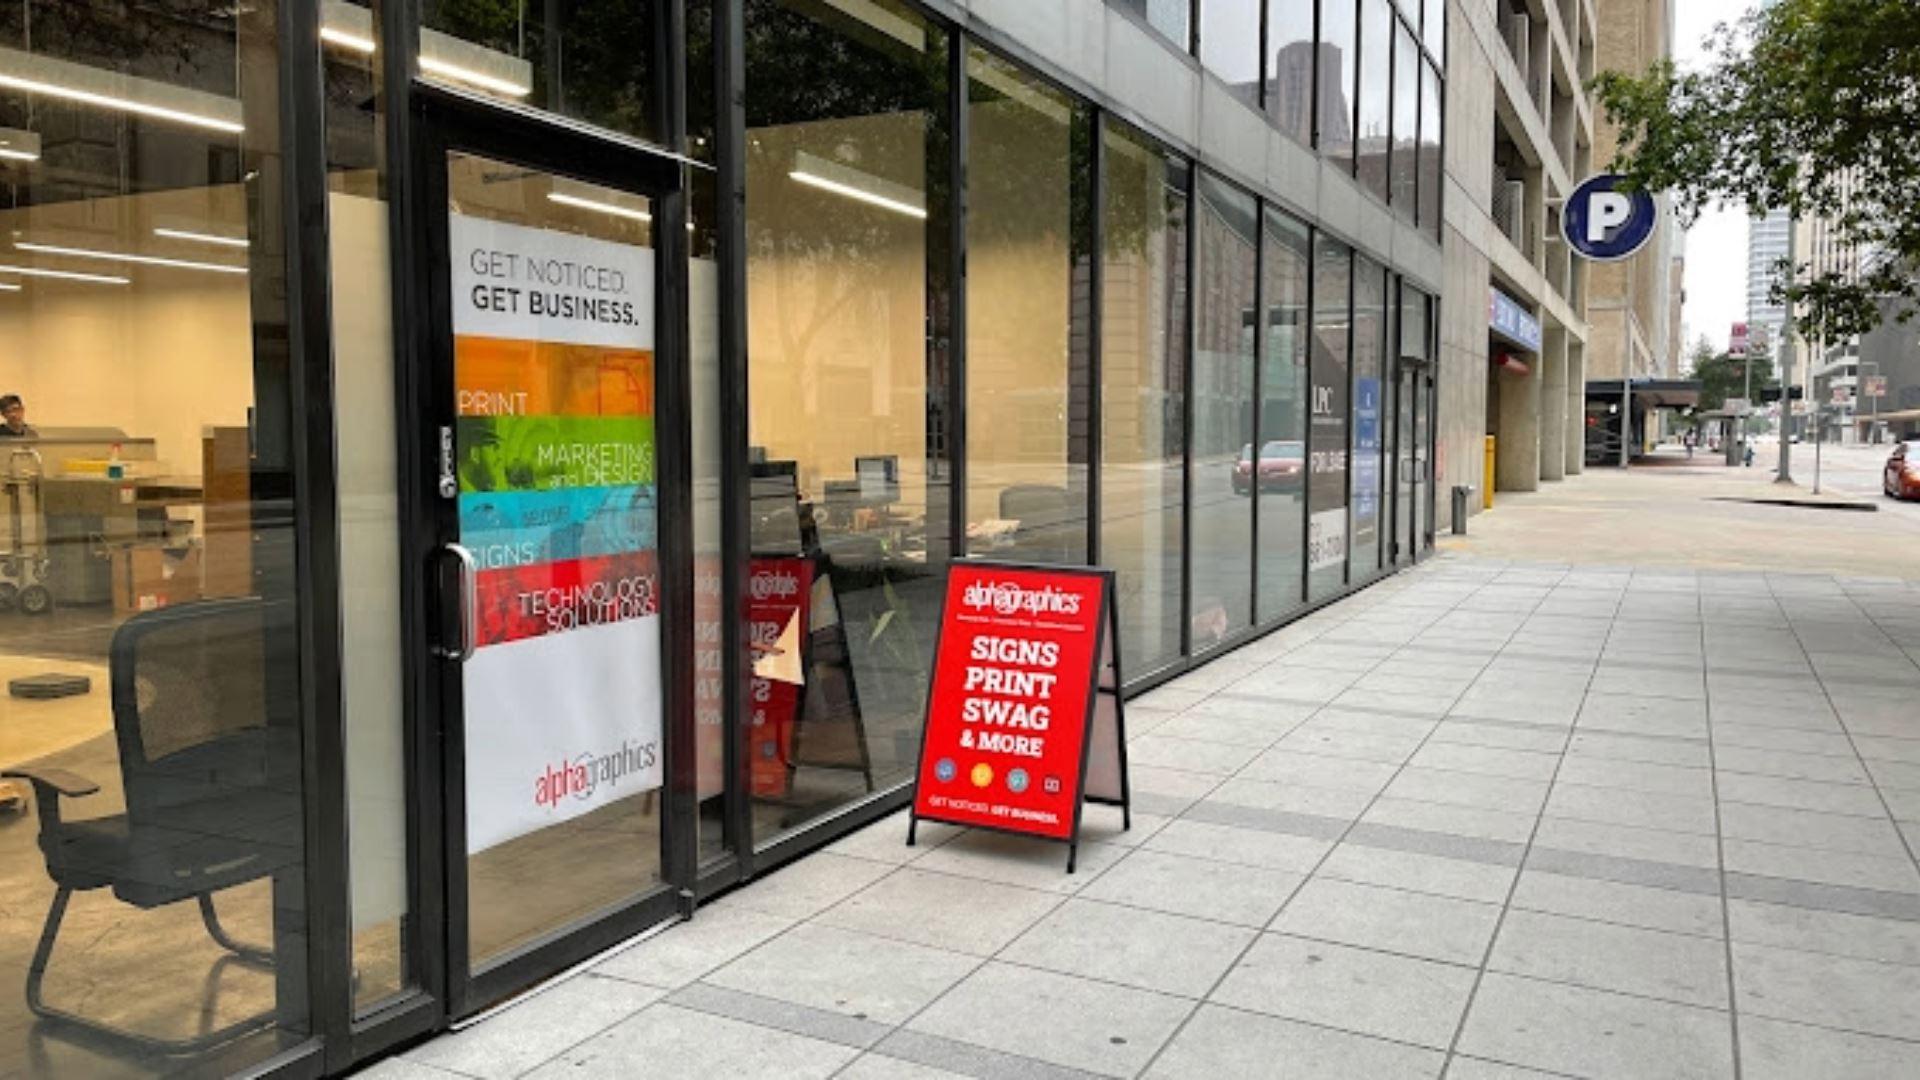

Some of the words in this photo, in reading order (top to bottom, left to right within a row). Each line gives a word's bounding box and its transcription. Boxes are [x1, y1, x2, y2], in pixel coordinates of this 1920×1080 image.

[1588, 192, 1630, 241] P
[470, 249, 518, 279] GET
[472, 285, 521, 313] GET
[530, 290, 639, 326] BUSINESS.
[458, 389, 528, 416] PRINT
[538, 442, 652, 467] MARKETING
[551, 472, 580, 488] and
[518, 573, 656, 617] TECHNOLOGY
[963, 580, 1081, 616] alphagraphics
[546, 598, 657, 634] SOLUTIONS
[970, 635, 1060, 667] SIGNS
[964, 666, 1057, 699] PRINT
[962, 698, 1050, 731] SWAG
[960, 729, 975, 748] &
[977, 732, 1044, 759] MORE
[535, 741, 658, 808] alphagraphics
